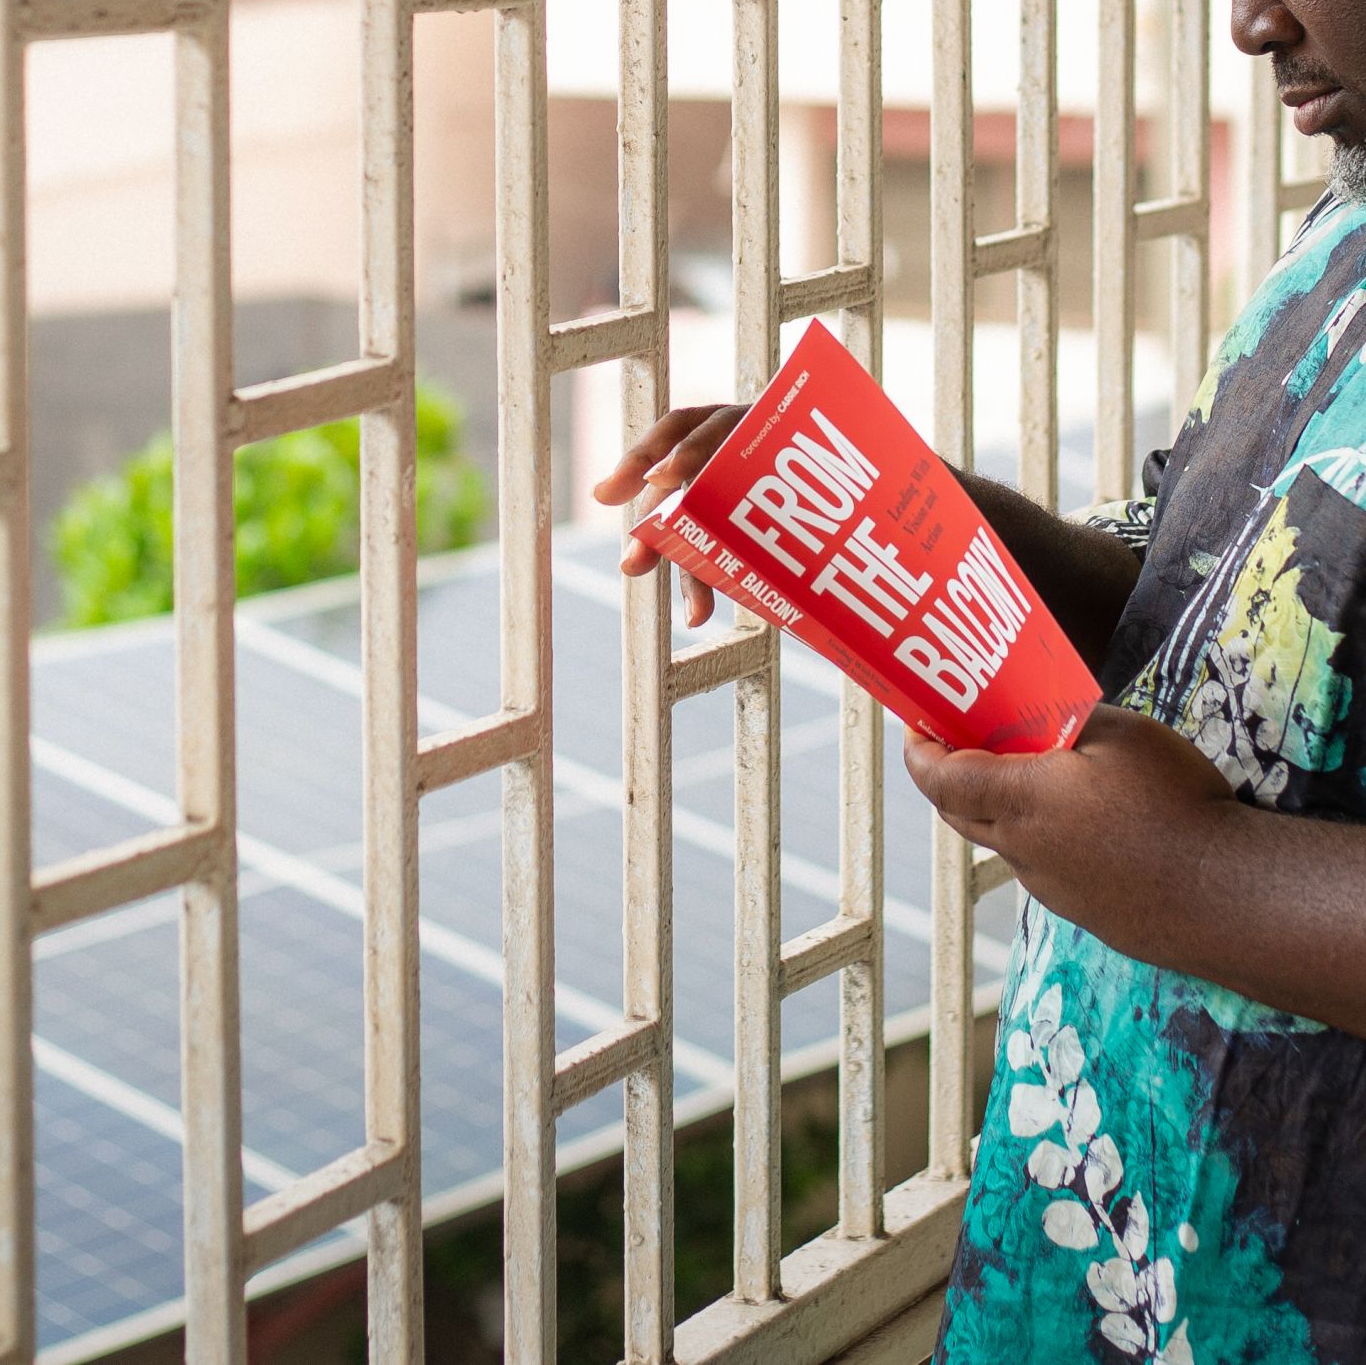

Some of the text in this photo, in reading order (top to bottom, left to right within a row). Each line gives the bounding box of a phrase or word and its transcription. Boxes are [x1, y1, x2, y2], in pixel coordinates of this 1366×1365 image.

[728, 407, 881, 578] FROM
[740, 421, 773, 459] Foreword
[768, 410, 781, 425] by
[672, 514, 804, 626] FROM THE BALCONY
[810, 516, 934, 639] THE
[893, 526, 1032, 714] BALCONY
